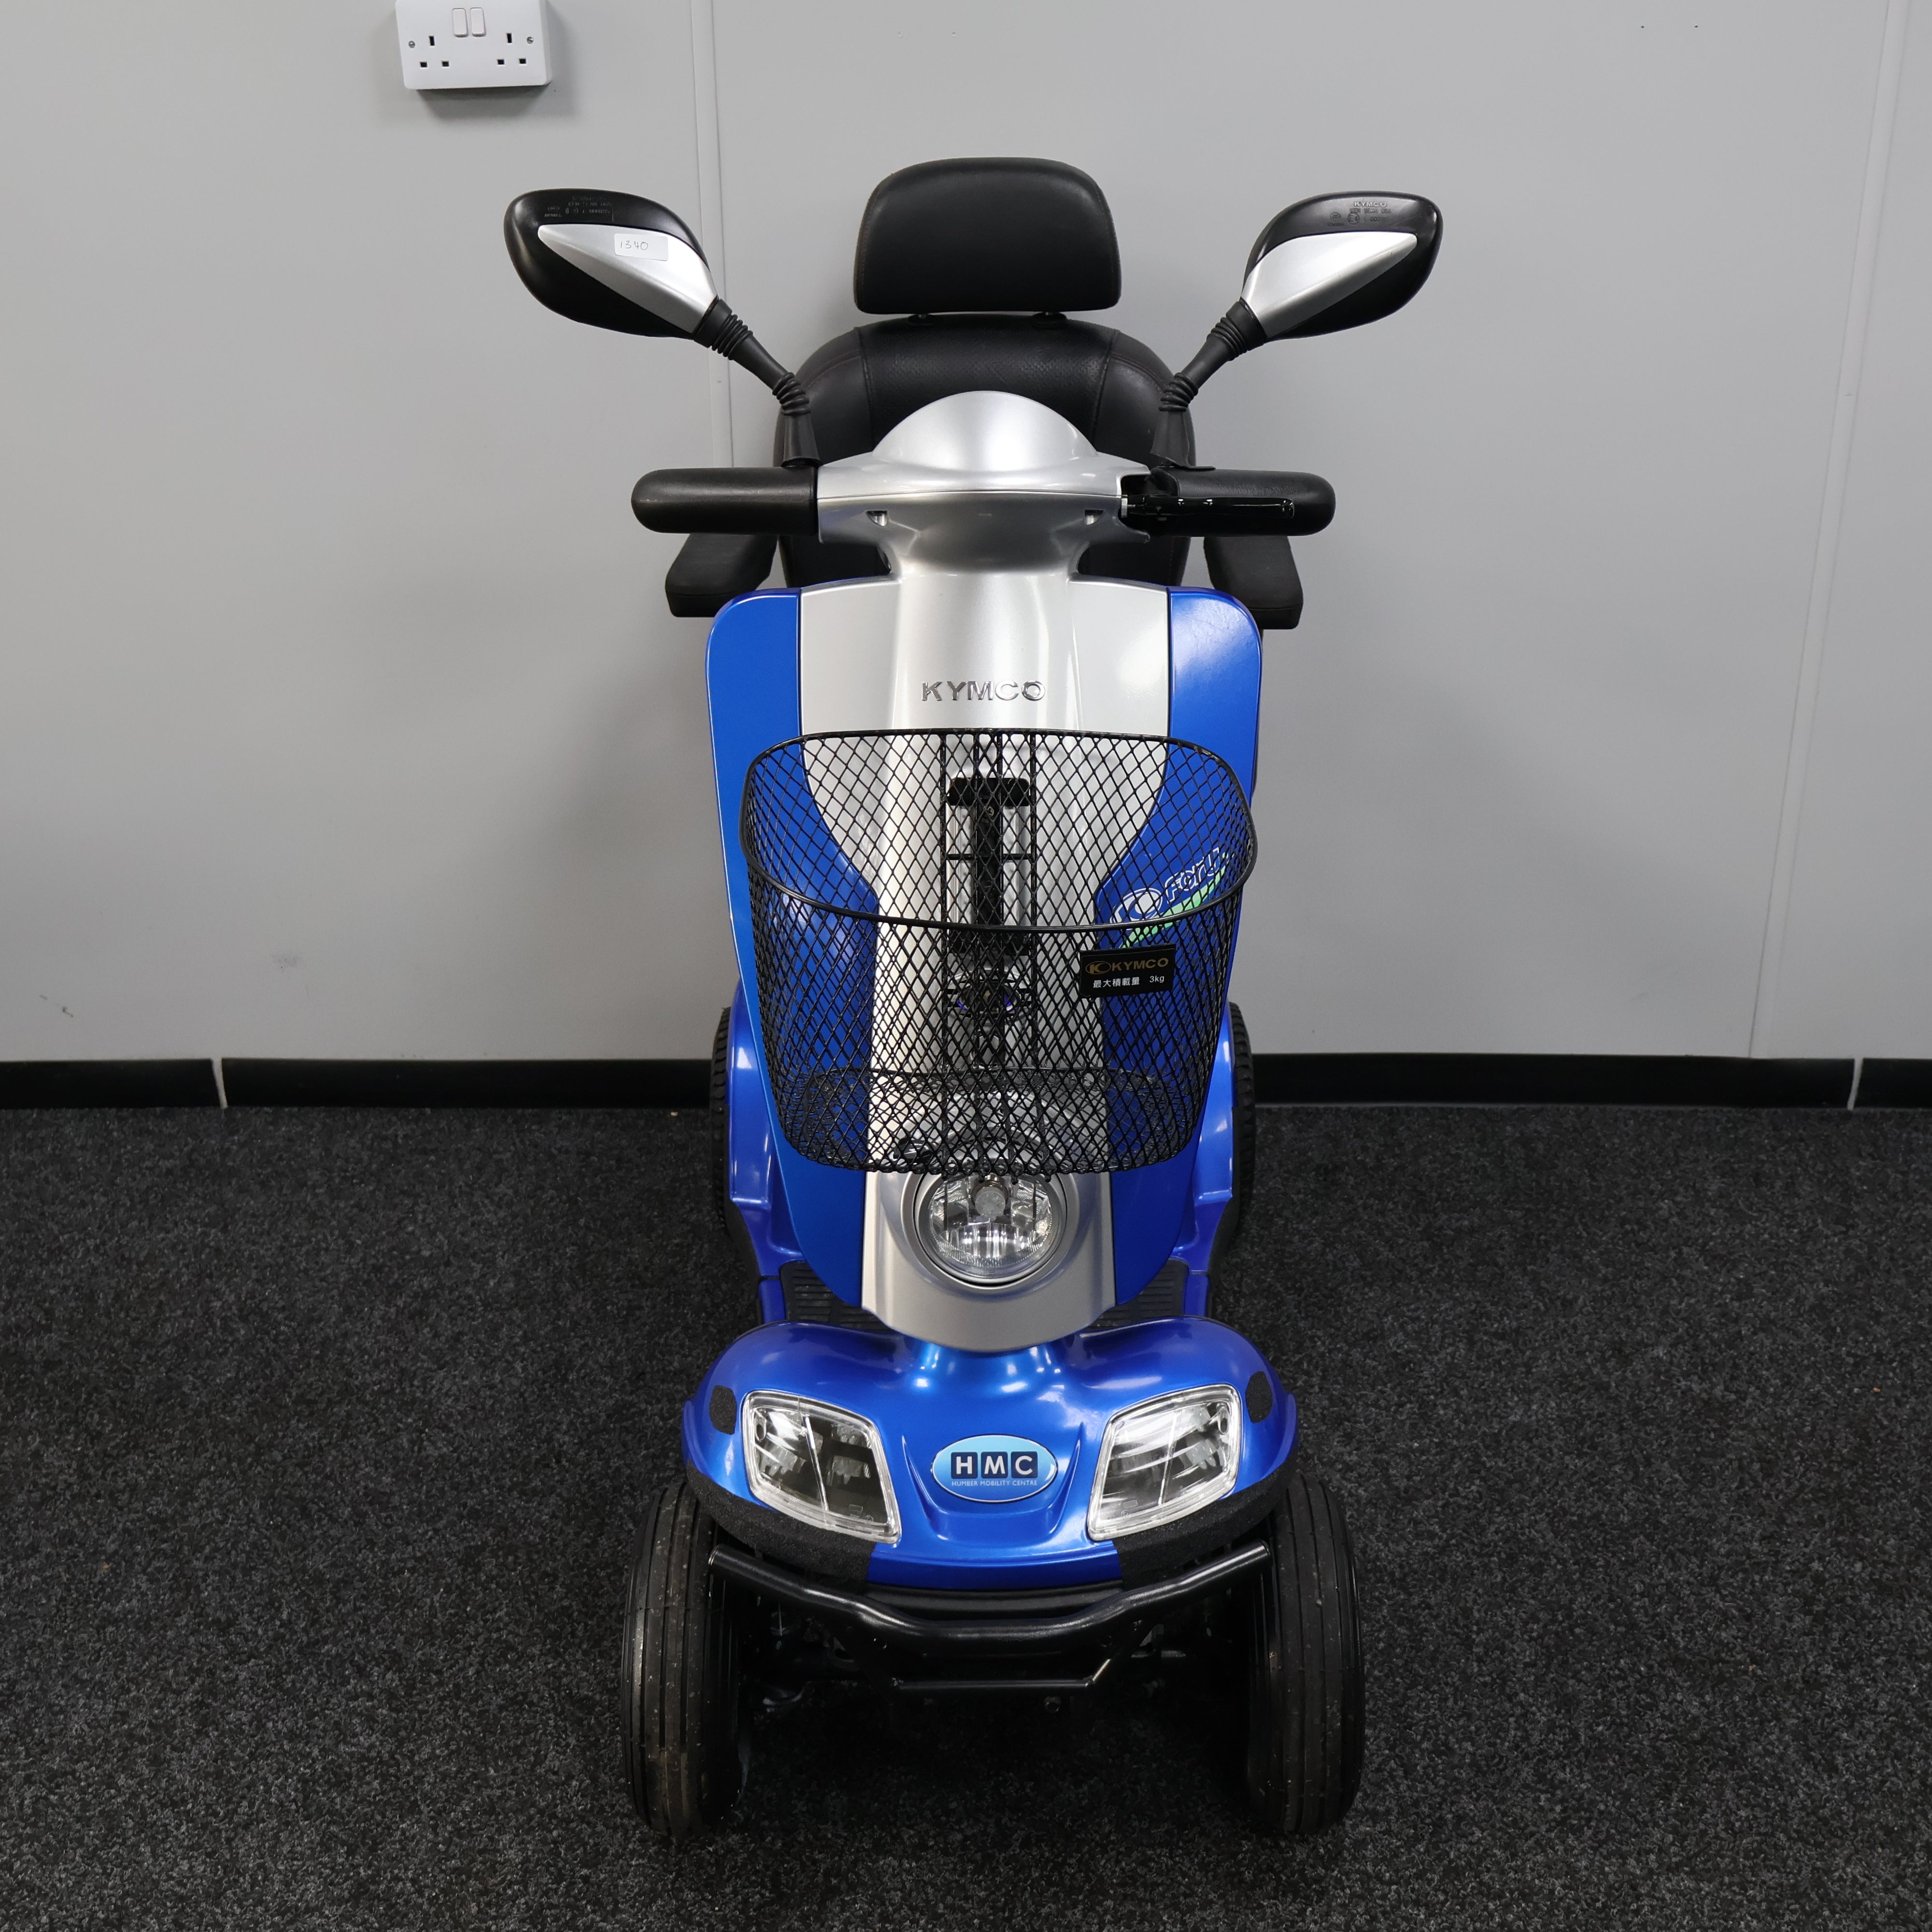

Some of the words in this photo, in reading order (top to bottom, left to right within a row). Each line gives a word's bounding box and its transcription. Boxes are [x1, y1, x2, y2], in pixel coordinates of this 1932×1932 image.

[620, 240, 649, 251] 1340
[921, 680, 1046, 701] KYMCO
[1111, 957, 1169, 972] KYMCO
[1093, 977, 1140, 989] 最大積載量
[1149, 975, 1165, 984] 3kg
[955, 1455, 1033, 1475] HMC
